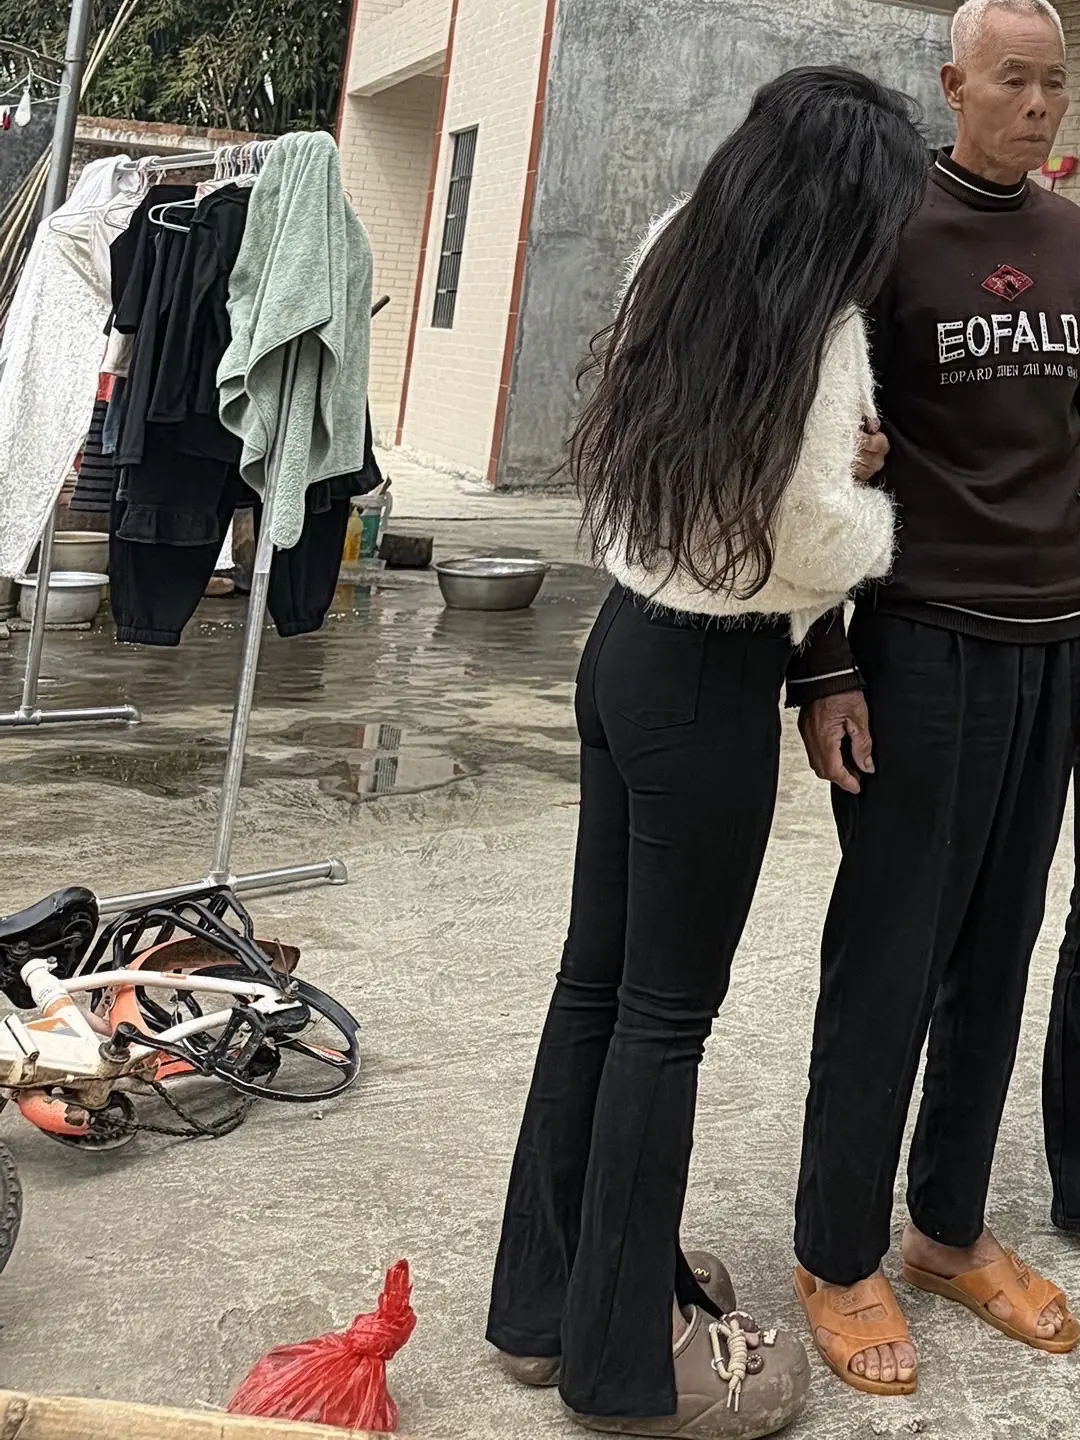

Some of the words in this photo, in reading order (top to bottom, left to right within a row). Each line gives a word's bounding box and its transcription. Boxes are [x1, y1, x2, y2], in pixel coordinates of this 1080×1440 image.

[937, 311, 1080, 364] EOFALD
[939, 366, 993, 385] EOPARD
[1022, 363, 1040, 376] ZHI
